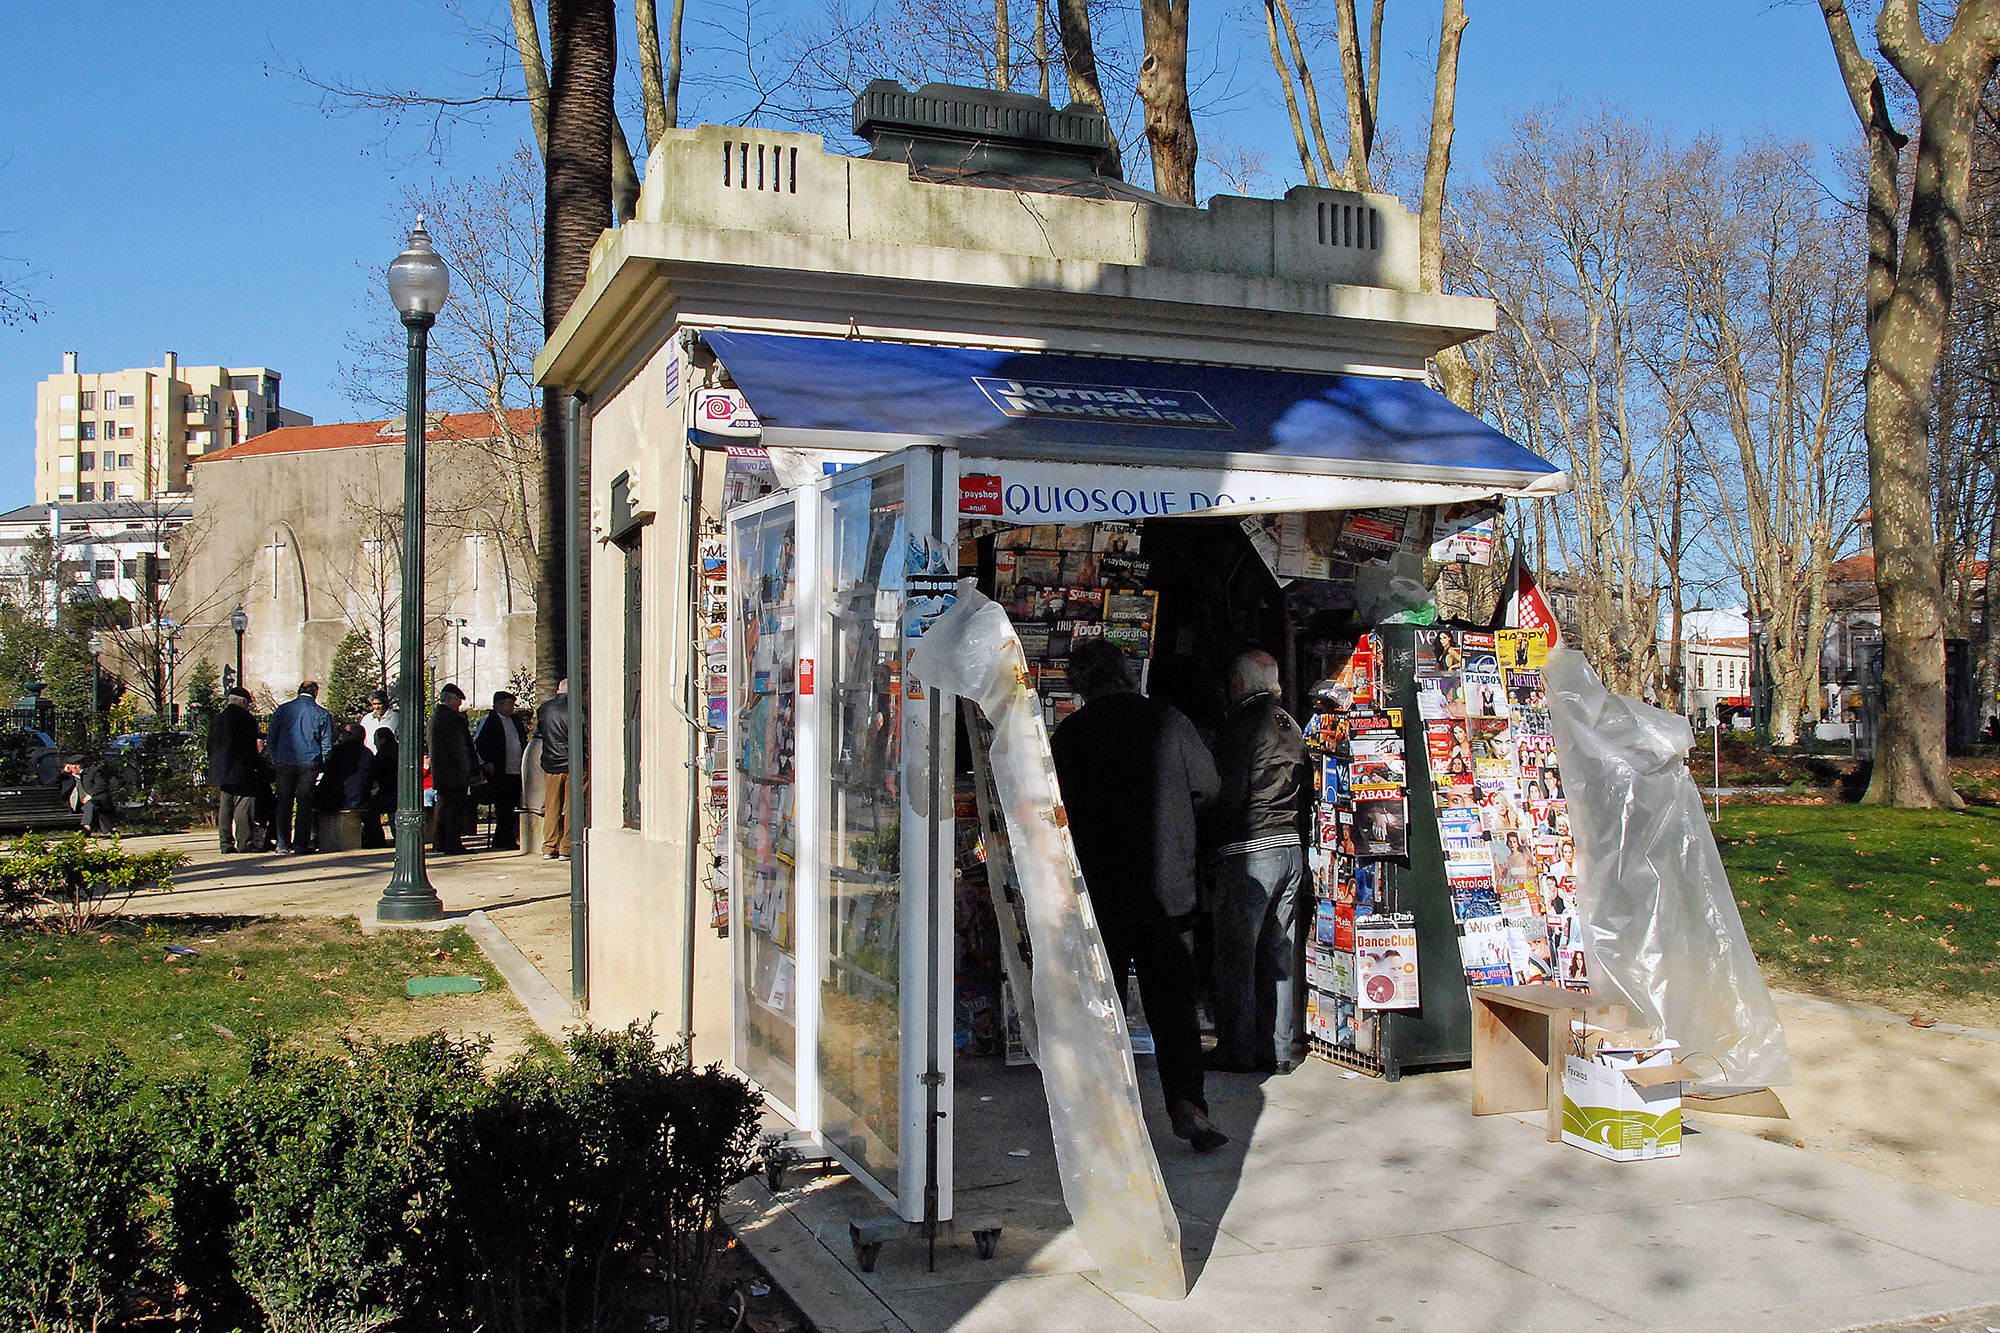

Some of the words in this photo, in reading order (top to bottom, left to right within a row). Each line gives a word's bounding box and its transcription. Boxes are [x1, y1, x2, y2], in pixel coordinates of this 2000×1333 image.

[998, 381, 1148, 404] Jornal
[1148, 397, 1180, 407] de
[965, 491, 998, 500] payshop
[1069, 589, 1101, 600] SUPER
[1073, 623, 1102, 636] foto
[1103, 627, 1148, 640] Fotografia
[1463, 634, 1489, 645] SUPER
[1465, 674, 1501, 684] PLAYBOY
[1349, 716, 1390, 729] VISÃO
[1357, 935, 1415, 947] DanceClub
